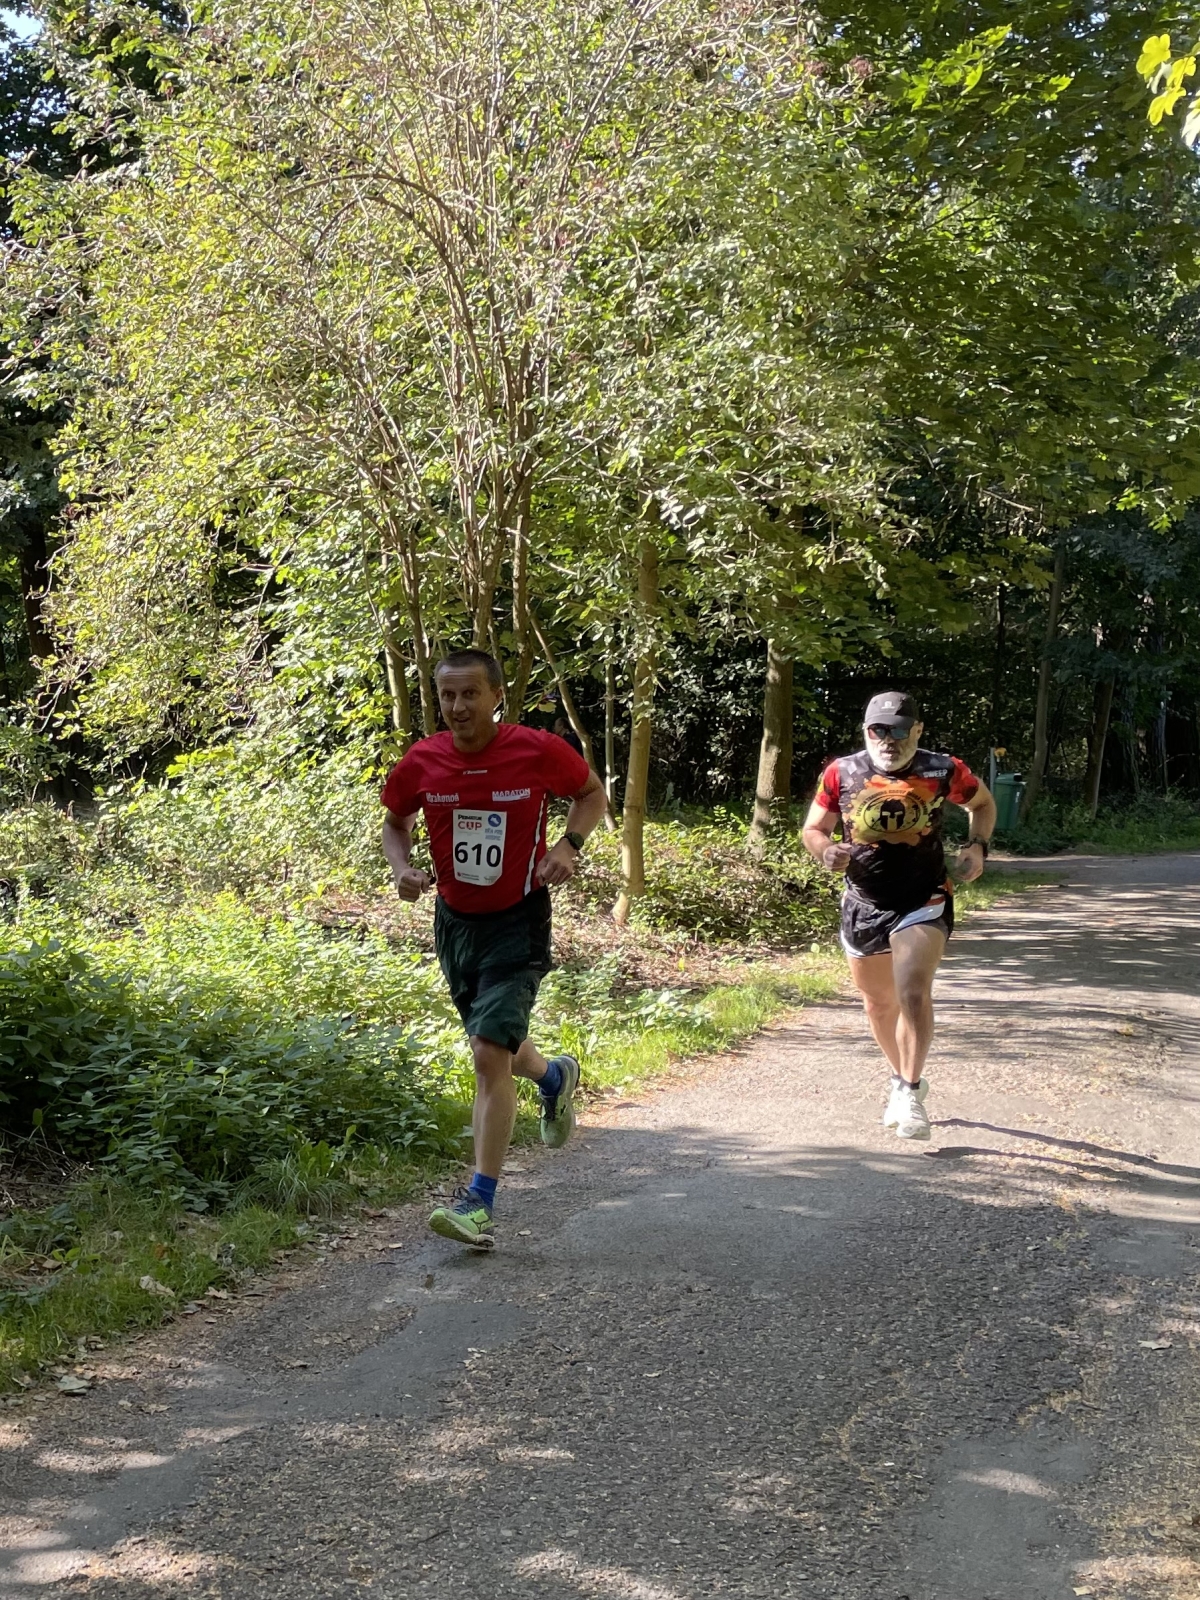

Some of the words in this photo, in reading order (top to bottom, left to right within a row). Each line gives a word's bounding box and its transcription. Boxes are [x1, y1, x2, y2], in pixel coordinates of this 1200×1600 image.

[492, 788, 531, 798] MARATON
[458, 821, 482, 831] CUP
[454, 841, 502, 868] 610
